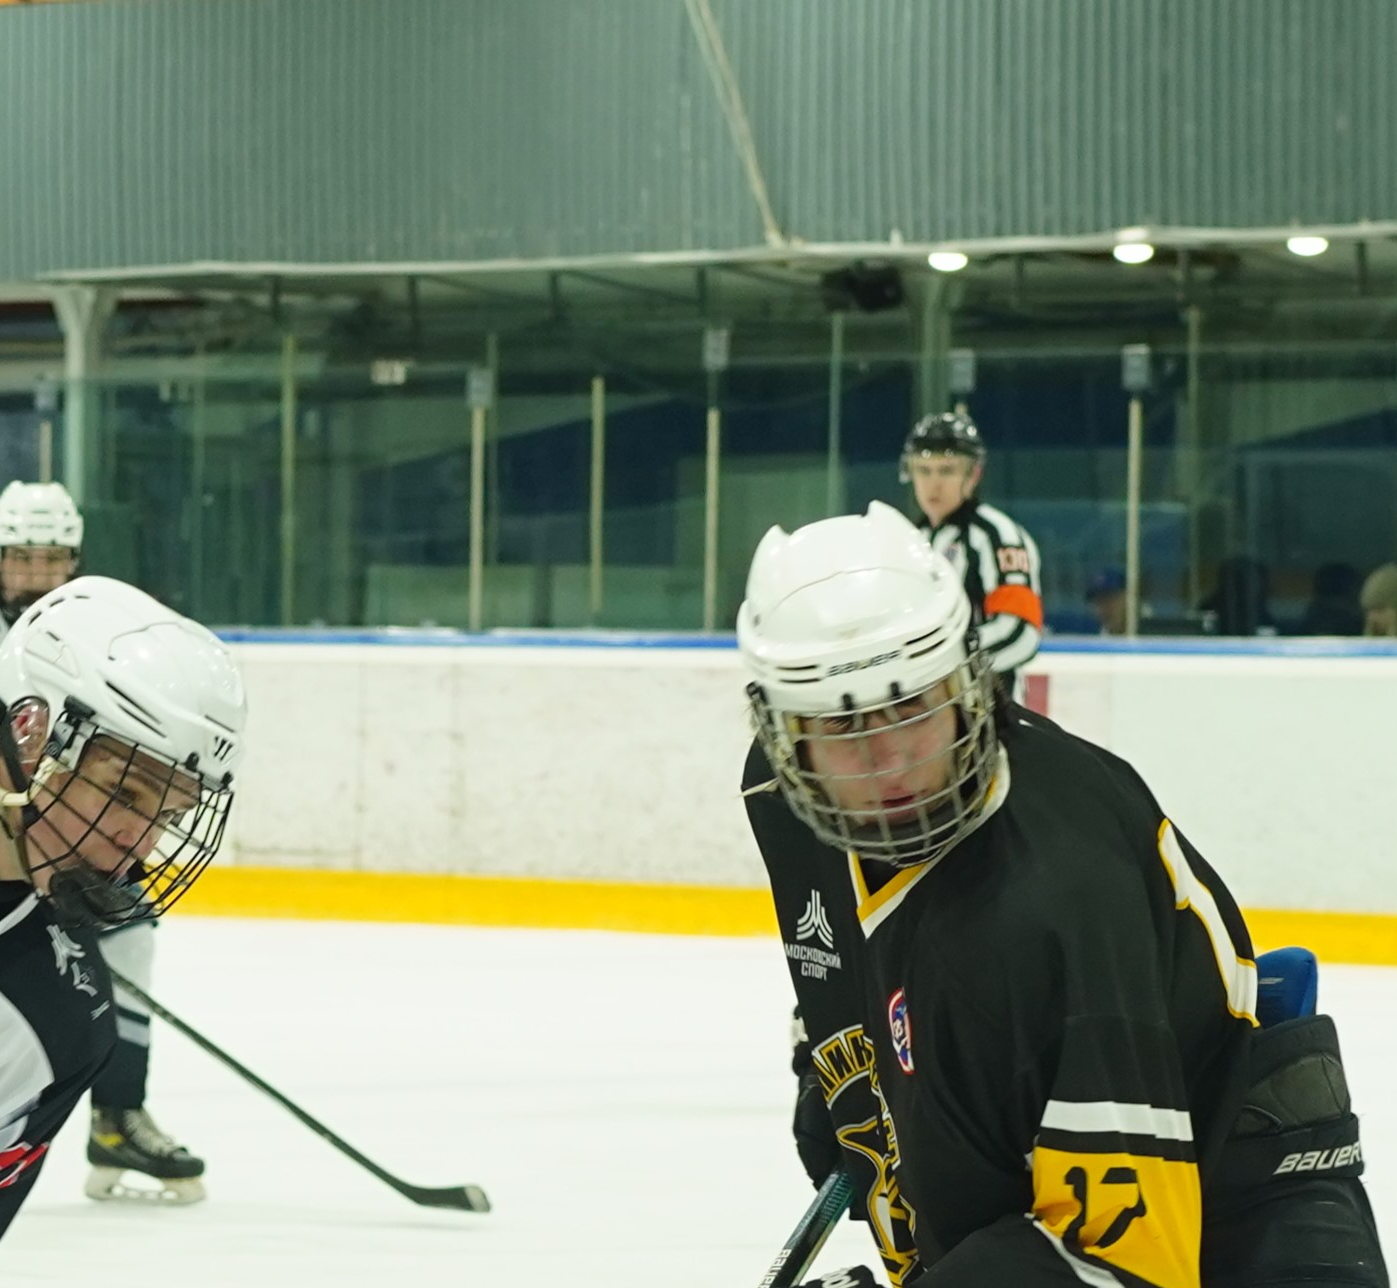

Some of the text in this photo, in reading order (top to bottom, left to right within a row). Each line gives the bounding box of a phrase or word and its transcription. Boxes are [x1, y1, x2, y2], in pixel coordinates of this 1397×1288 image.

[784, 943, 842, 970] МОСКОВСКИЙ
[800, 961, 828, 981] СПОРТ
[1272, 1140, 1362, 1175] BAUER
[1062, 1166, 1147, 1253] 17
